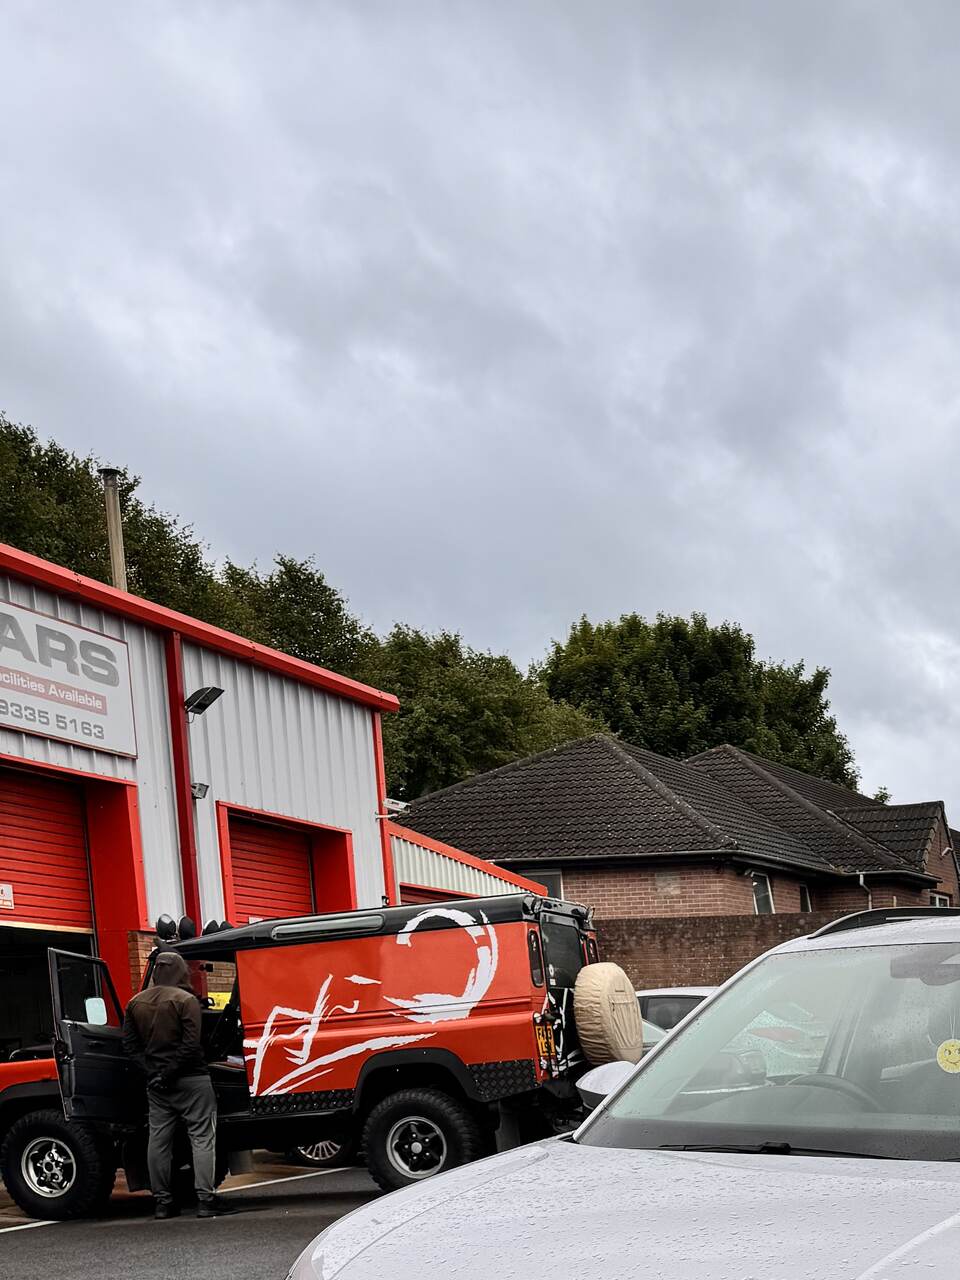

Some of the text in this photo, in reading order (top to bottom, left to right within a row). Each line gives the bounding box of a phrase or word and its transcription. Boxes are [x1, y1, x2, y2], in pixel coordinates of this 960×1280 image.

[0, 673, 103, 710] cilities Available
[56, 713, 105, 740] 5163
